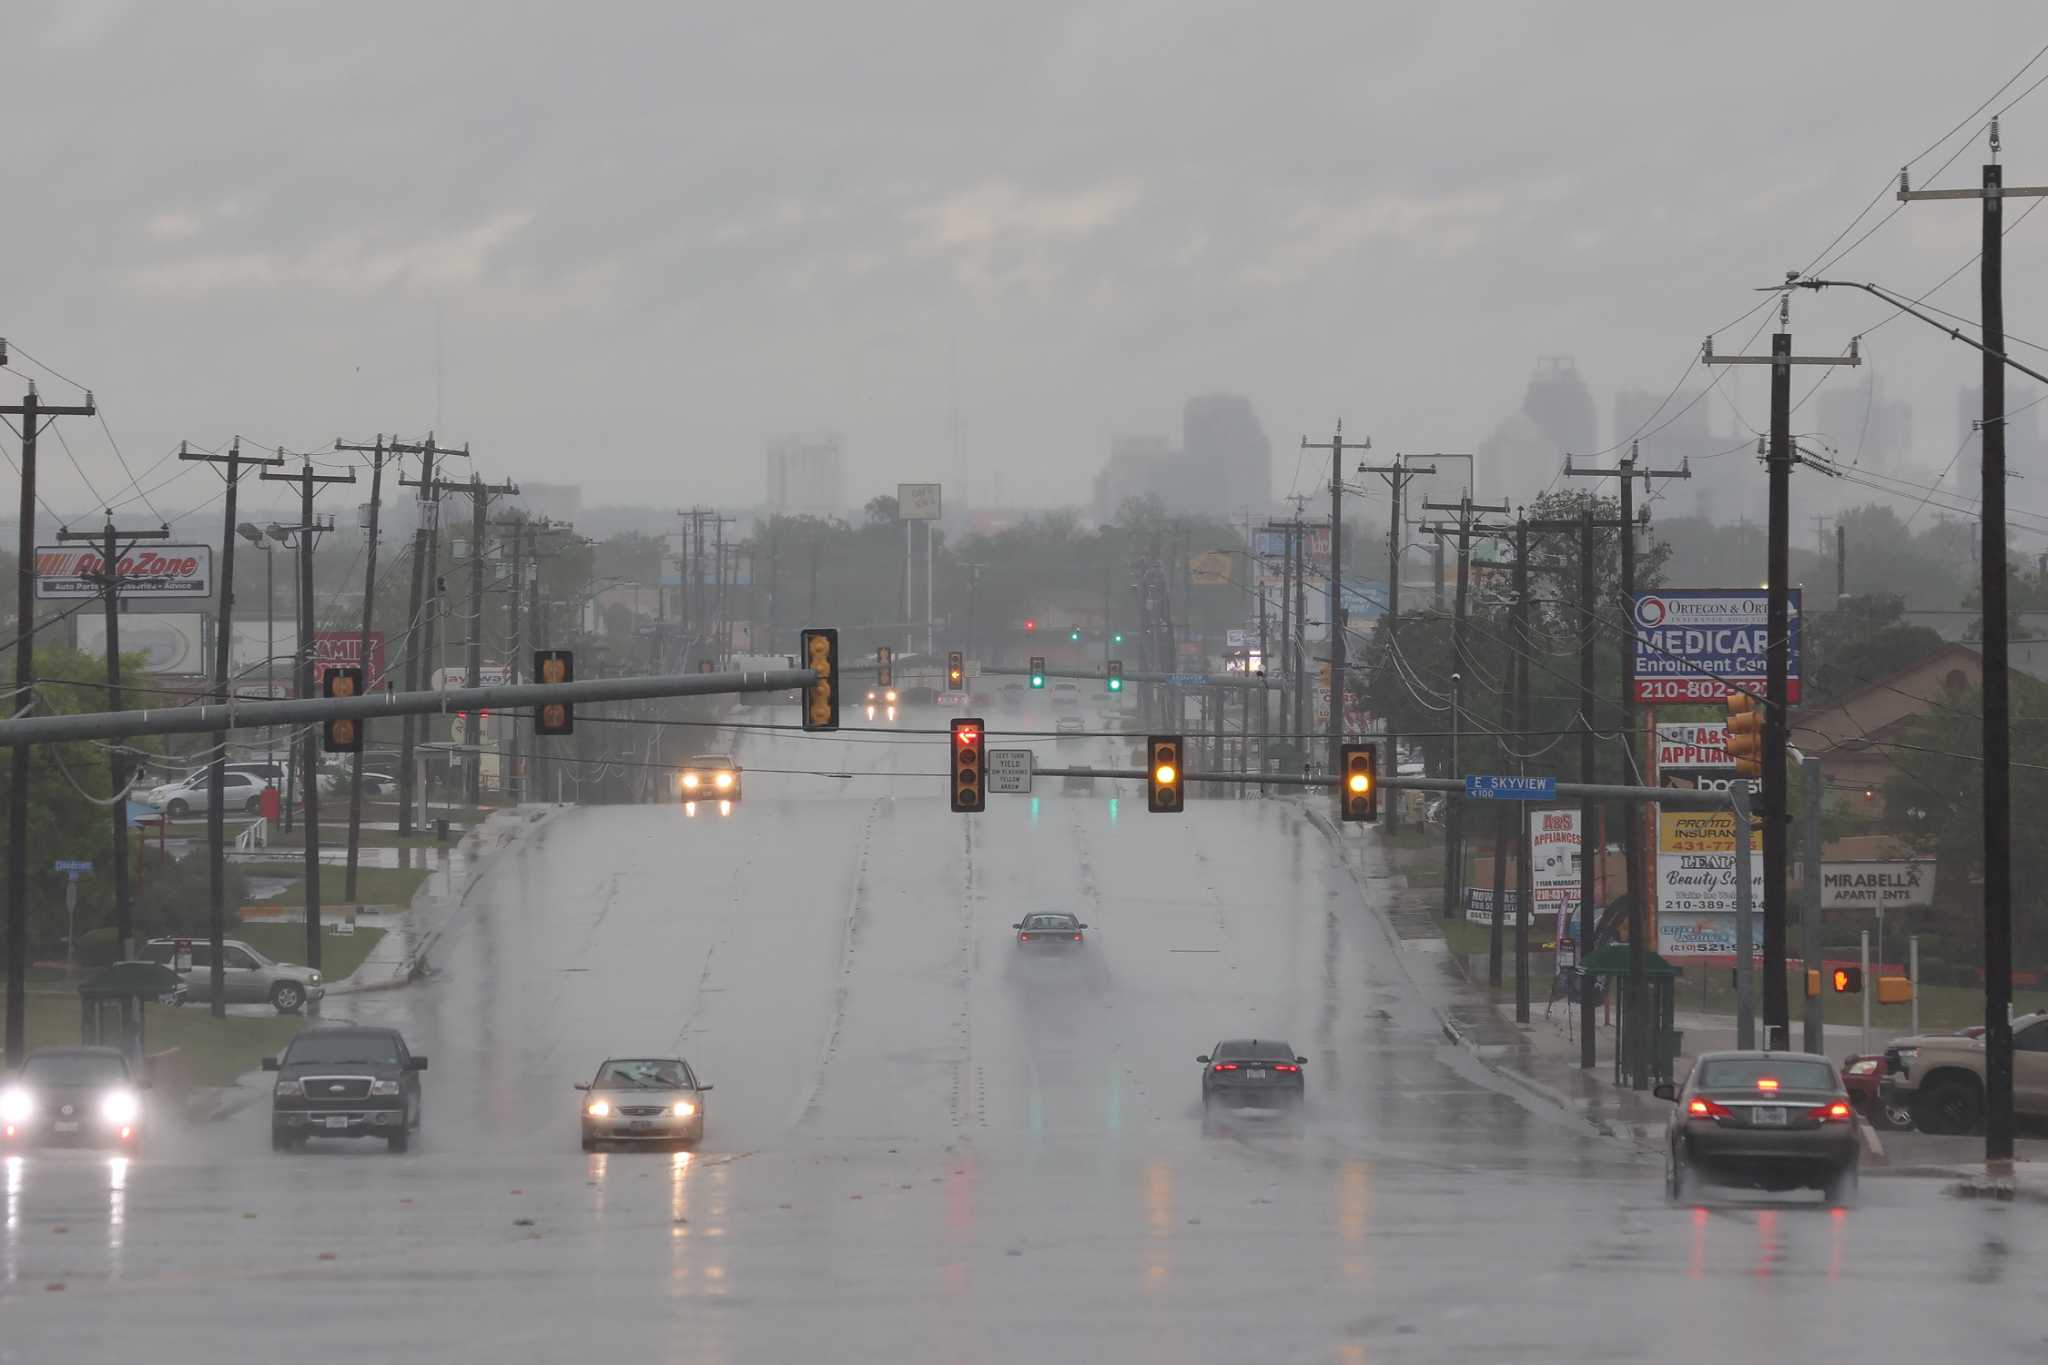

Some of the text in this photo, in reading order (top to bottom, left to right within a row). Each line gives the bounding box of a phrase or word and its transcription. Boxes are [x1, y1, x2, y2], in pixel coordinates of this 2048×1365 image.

[73, 552, 198, 576] AuoZone
[1730, 604, 1739, 614] &
[1742, 600, 1768, 614] ORT
[1728, 616, 1768, 624] SOLUTIO
[1637, 630, 1791, 654] MEDICAR
[313, 640, 378, 660] FAMIY
[1636, 656, 1792, 672] Enrollment Cenr
[1661, 747, 1737, 763] APPLIAN
[1000, 760, 1021, 768] YIELD
[1475, 776, 1545, 790] E SKYVIEW
[1674, 829, 1756, 838] INSURAN
[1681, 855, 1735, 869] LEAL'
[1666, 870, 1762, 892] Beauty San
[1824, 873, 1920, 888] MIRABELLA
[1835, 890, 1911, 900] APARTENTS
